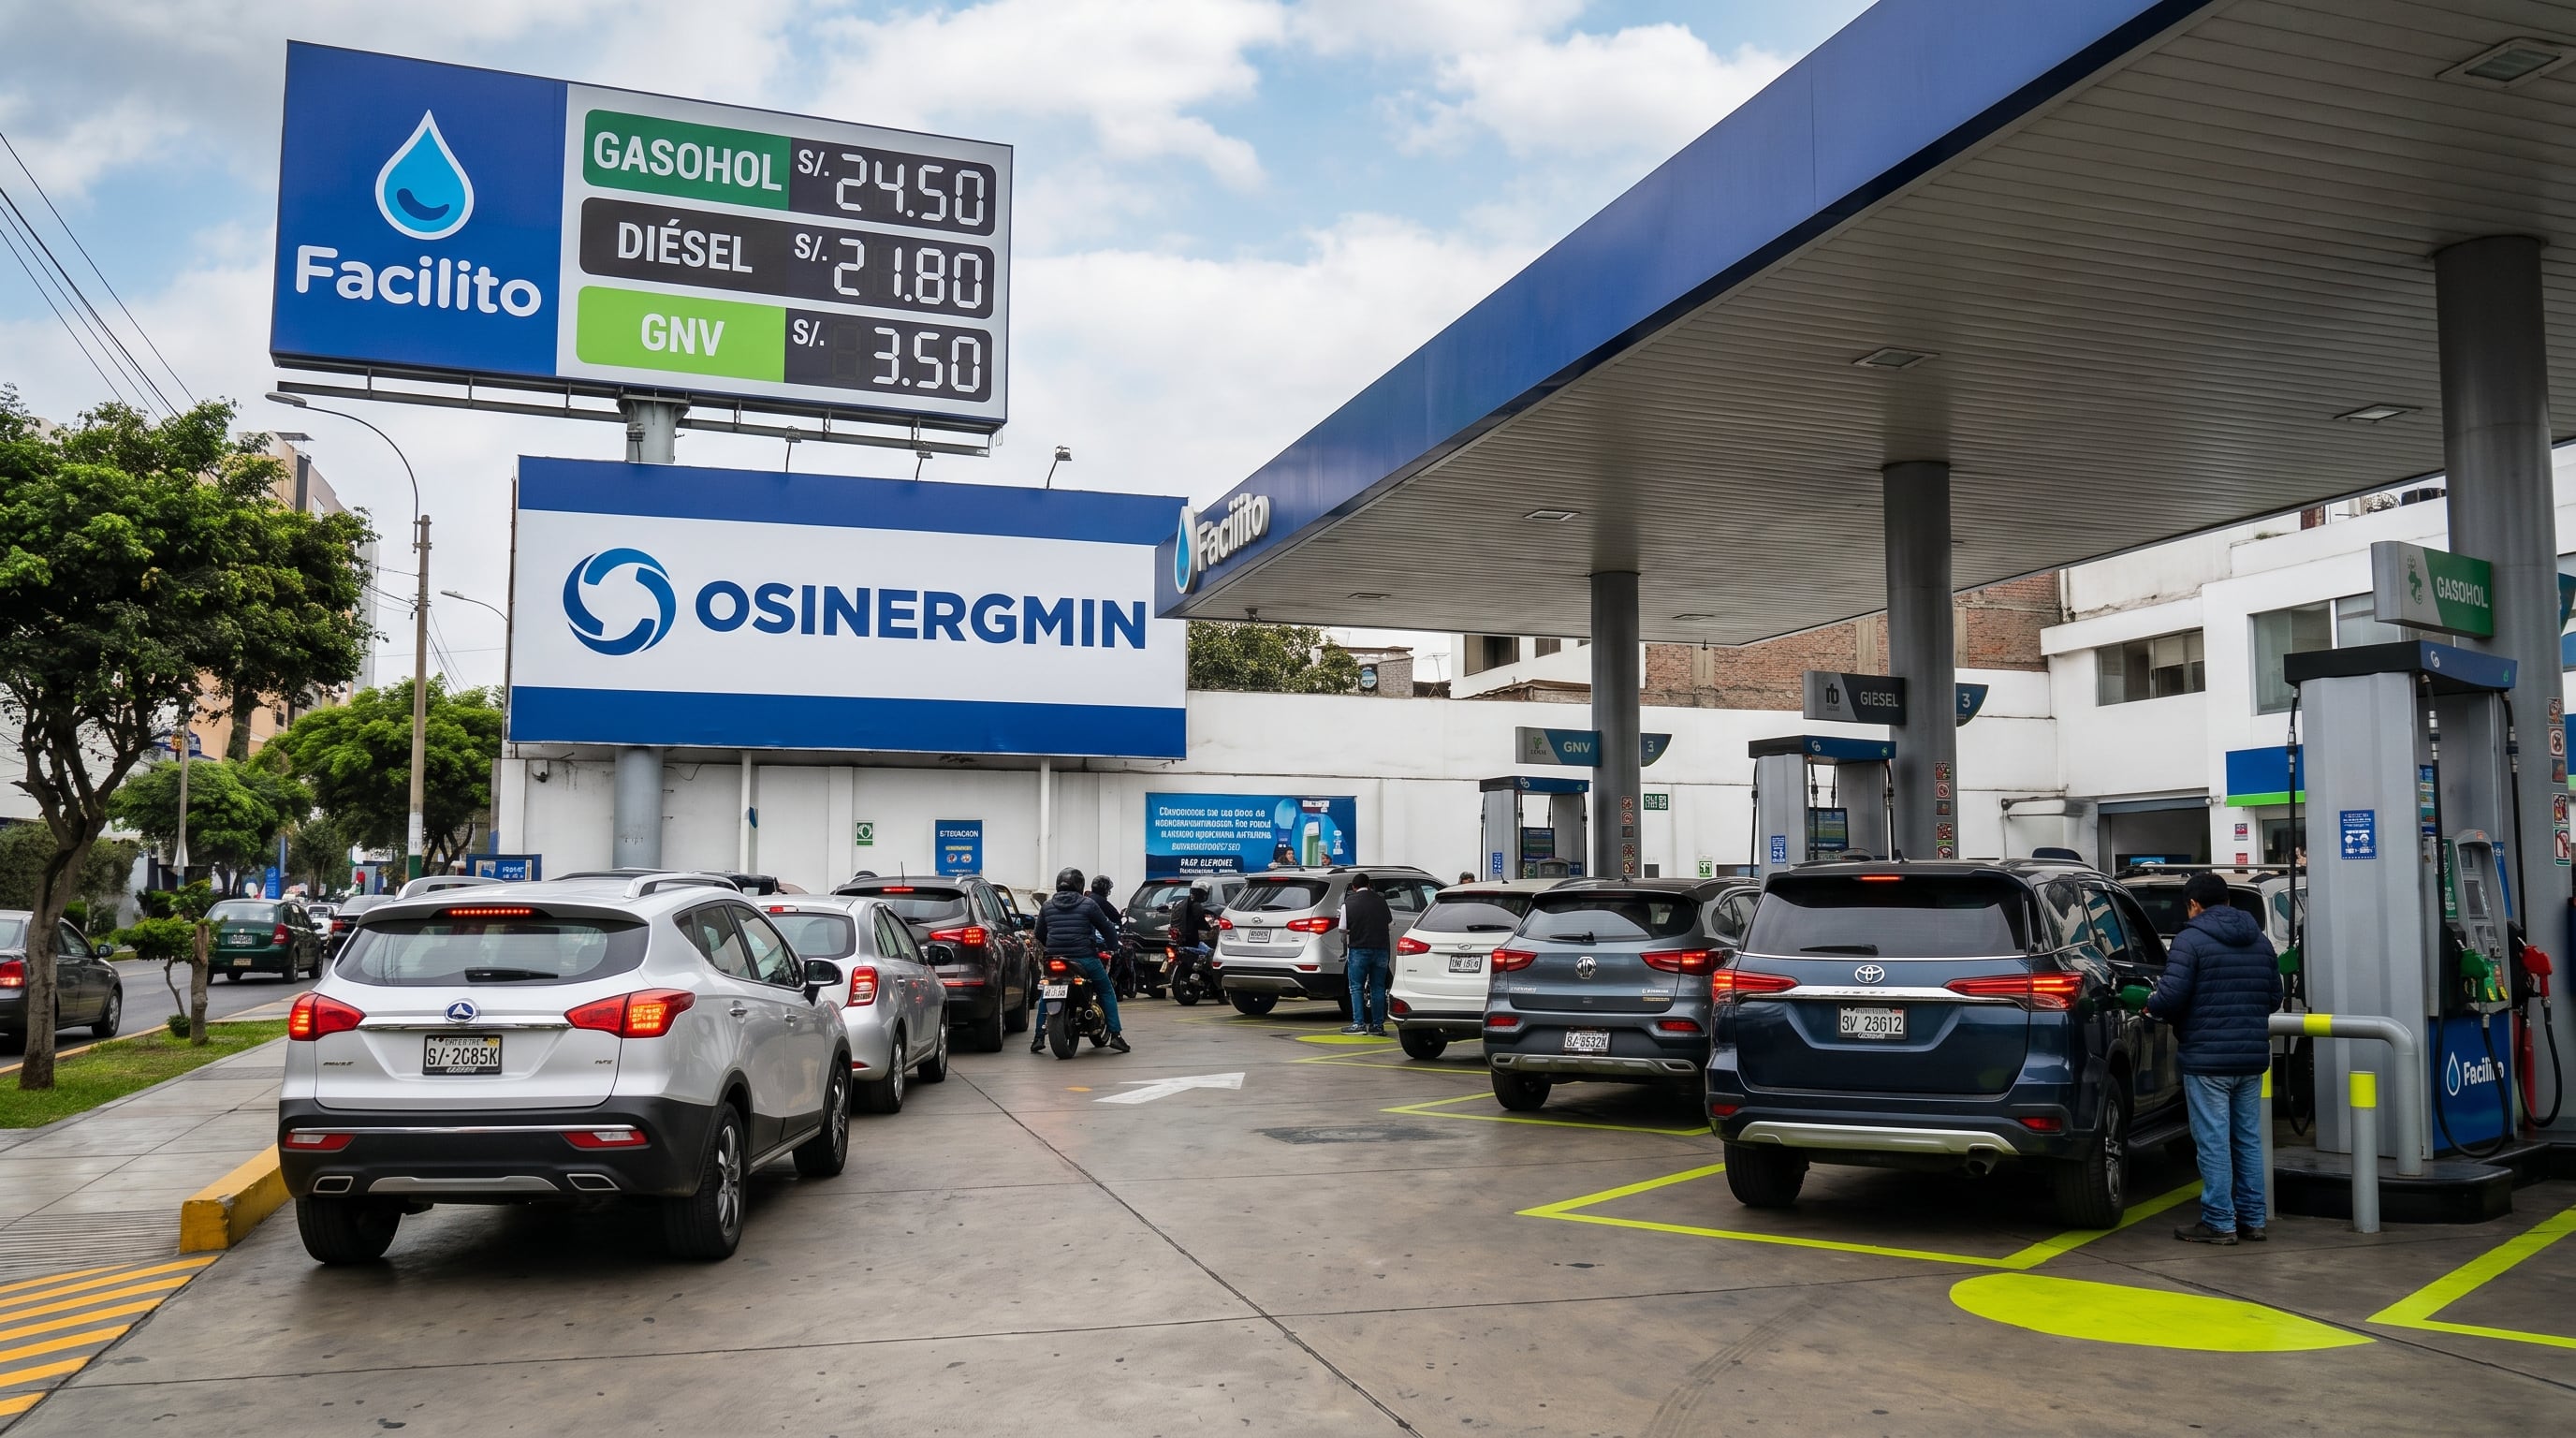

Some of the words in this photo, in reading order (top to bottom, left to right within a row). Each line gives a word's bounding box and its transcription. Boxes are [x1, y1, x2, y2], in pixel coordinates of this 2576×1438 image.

[593, 130, 783, 192] GASOHOL
[798, 148, 830, 178] S/.
[836, 153, 984, 227] 24.50
[296, 243, 541, 317] Facilito
[618, 218, 754, 273] DIÉSEL
[794, 232, 828, 262] S/.
[833, 237, 983, 310] 21.80
[640, 312, 725, 358] GNV
[792, 318, 825, 347] S/.
[872, 326, 981, 393] 3.50
[695, 580, 1146, 650] OSINERGMIN
[2437, 576, 2489, 609] GASOHOL
[1962, 693, 1970, 709] 3
[1563, 741, 1591, 754] GNV
